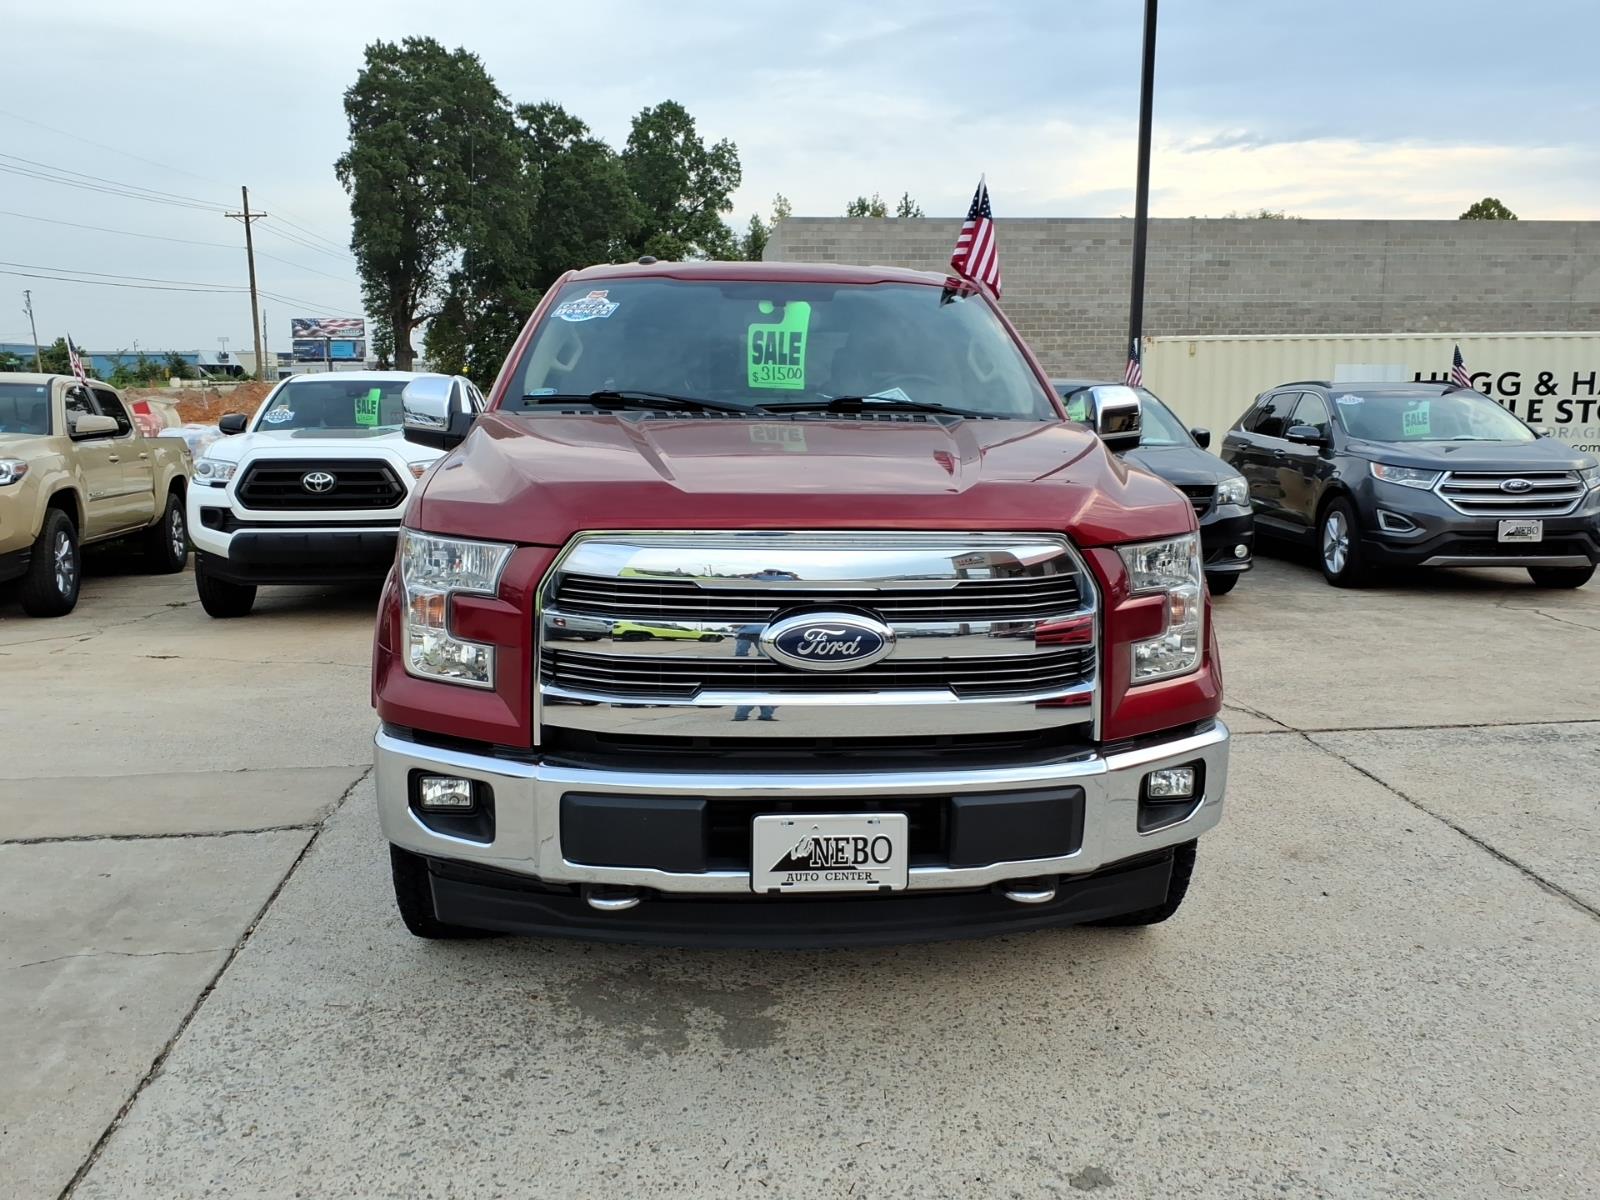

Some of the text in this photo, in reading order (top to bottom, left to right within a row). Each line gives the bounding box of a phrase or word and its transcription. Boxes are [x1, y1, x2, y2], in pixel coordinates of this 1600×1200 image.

[752, 330, 802, 366] SALE
[1534, 371, 1559, 396] &
[1572, 371, 1600, 395] H
[356, 400, 377, 415] SALE
[1405, 411, 1428, 427] SALE
[1555, 399, 1600, 424] ST
[797, 628, 862, 655] Ford
[810, 835, 893, 866] NEBO
[786, 872, 873, 882] AUTO CENTER
